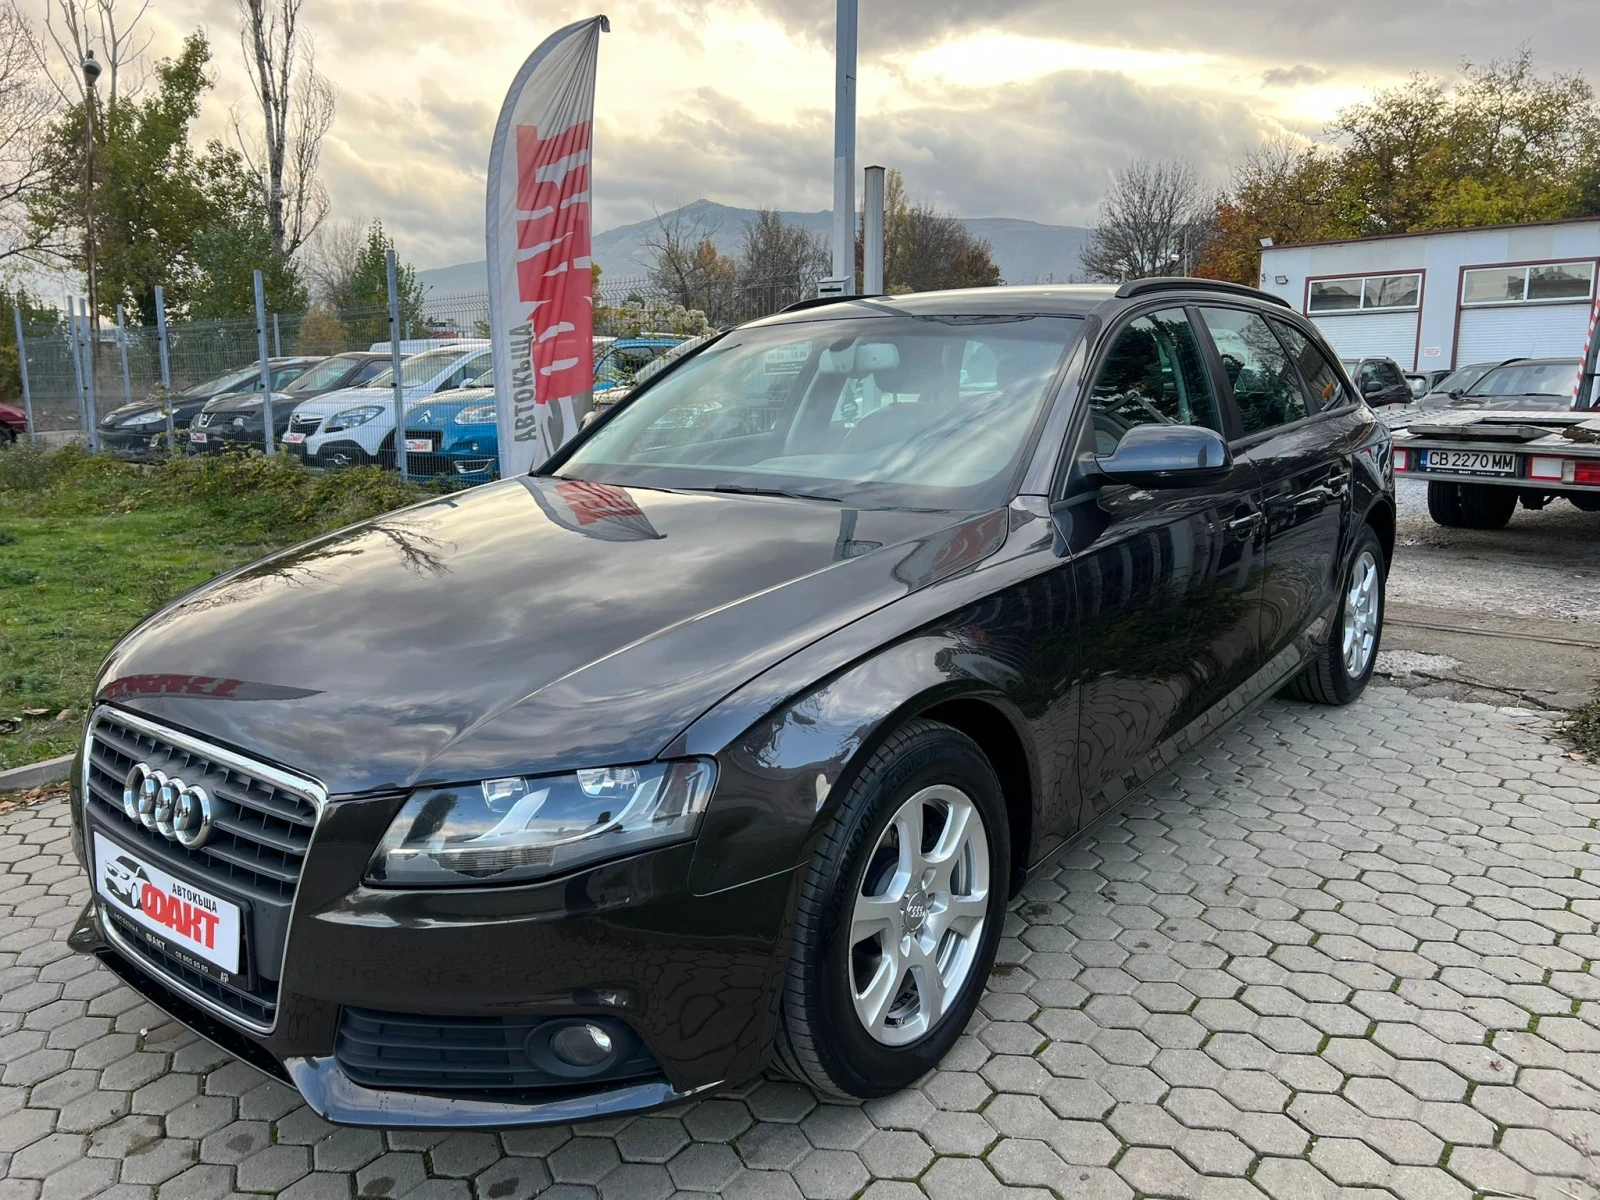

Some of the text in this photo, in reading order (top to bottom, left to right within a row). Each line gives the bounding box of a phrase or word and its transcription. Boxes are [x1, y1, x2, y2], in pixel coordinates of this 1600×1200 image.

[516, 120, 593, 405] ФАКТ
[509, 323, 537, 443] АВТОКЪЩА
[1430, 452, 1513, 470] CB 2270 MM
[141, 883, 219, 950] ФАКТ
[171, 883, 217, 913] АВТОКЪЩА
